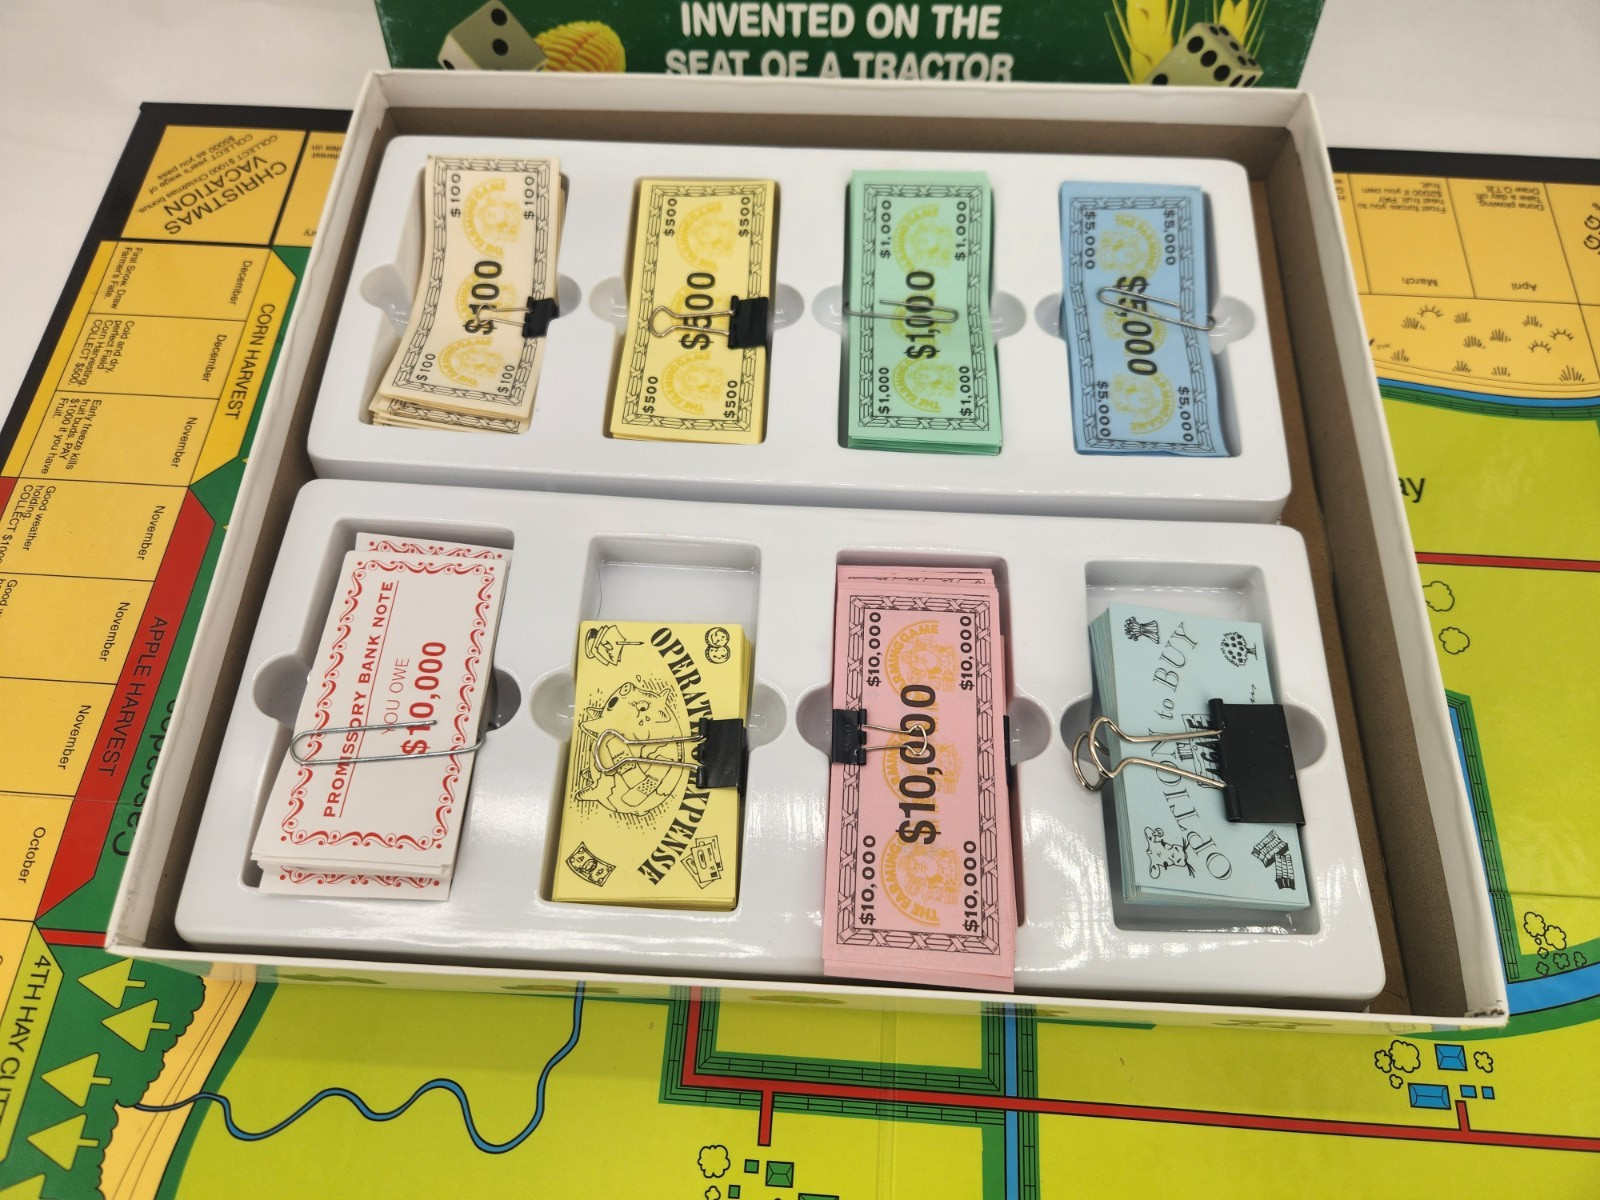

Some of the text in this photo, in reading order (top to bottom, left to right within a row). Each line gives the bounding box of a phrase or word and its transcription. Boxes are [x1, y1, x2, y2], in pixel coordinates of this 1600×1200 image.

[680, 2, 1003, 41] INVENTED ON THE
[665, 49, 1015, 83] SEAT OF A TRACTOR
[210, 134, 253, 161] COLLECT
[237, 135, 278, 161] COLLECT
[163, 155, 268, 217] VACATION
[164, 161, 287, 235] CHRISTMAS
[166, 173, 209, 198] Christmas
[450, 173, 462, 218] $100
[524, 176, 535, 220] $100
[663, 198, 677, 237] $500
[738, 196, 751, 238] $500
[879, 200, 892, 259] $1,000
[954, 201, 967, 261] $1,000
[1084, 211, 1096, 270] $5,000
[1163, 210, 1176, 266] $5,000
[112, 247, 133, 282] Farmer's
[131, 247, 143, 264] First
[111, 289, 127, 310] Draw
[229, 260, 253, 305] December
[462, 260, 503, 336] $100
[1402, 277, 1439, 288] March
[1511, 281, 1537, 292] April
[99, 319, 114, 340] Corn
[121, 320, 135, 339] Cold
[678, 272, 716, 351] $500
[903, 271, 940, 360] $1,000
[1112, 276, 1158, 376] $5,000
[79, 319, 103, 360] COLLECT
[97, 320, 123, 370] perfect Field
[114, 340, 127, 357] and
[201, 334, 228, 383] December
[225, 303, 275, 420] CORN HARVEST
[416, 353, 436, 382] $100
[497, 365, 515, 394] $100
[878, 367, 891, 415] $1,000
[959, 366, 973, 416] $1,000
[62, 398, 80, 425] $1000
[76, 398, 91, 418] fruit
[642, 376, 658, 414] $500
[723, 380, 738, 419] $500
[1097, 381, 1111, 437] $5,000
[1177, 386, 1194, 443] $5,000
[50, 434, 66, 451] you
[59, 442, 75, 461] PAY
[65, 399, 102, 470] Early freeze kills
[170, 416, 199, 469] November
[40, 452, 57, 474] have
[11, 484, 34, 532] COLLECT
[22, 485, 45, 521] holding.
[22, 485, 56, 552] Good weather
[137, 505, 166, 561] November
[0, 579, 18, 607] Good
[99, 601, 131, 662] November
[866, 612, 883, 687] $10,000
[900, 624, 939, 643] GAME
[959, 615, 975, 691] $10,000
[1152, 621, 1198, 692] BUY
[98, 616, 168, 777] APPLE HARVEST
[323, 581, 394, 818] PROMISSORY BANK NOTE
[381, 657, 410, 735] YOU OWE
[400, 642, 447, 756] $10,000
[1157, 697, 1174, 721] to
[57, 704, 92, 770] November
[895, 684, 944, 844] $10,000
[18, 826, 46, 884] October
[859, 835, 877, 926] $10,000
[962, 841, 980, 933] $10,000
[911, 903, 940, 923] THE
[24, 955, 51, 1001] 4TH
[9, 1006, 38, 1052] HAY
